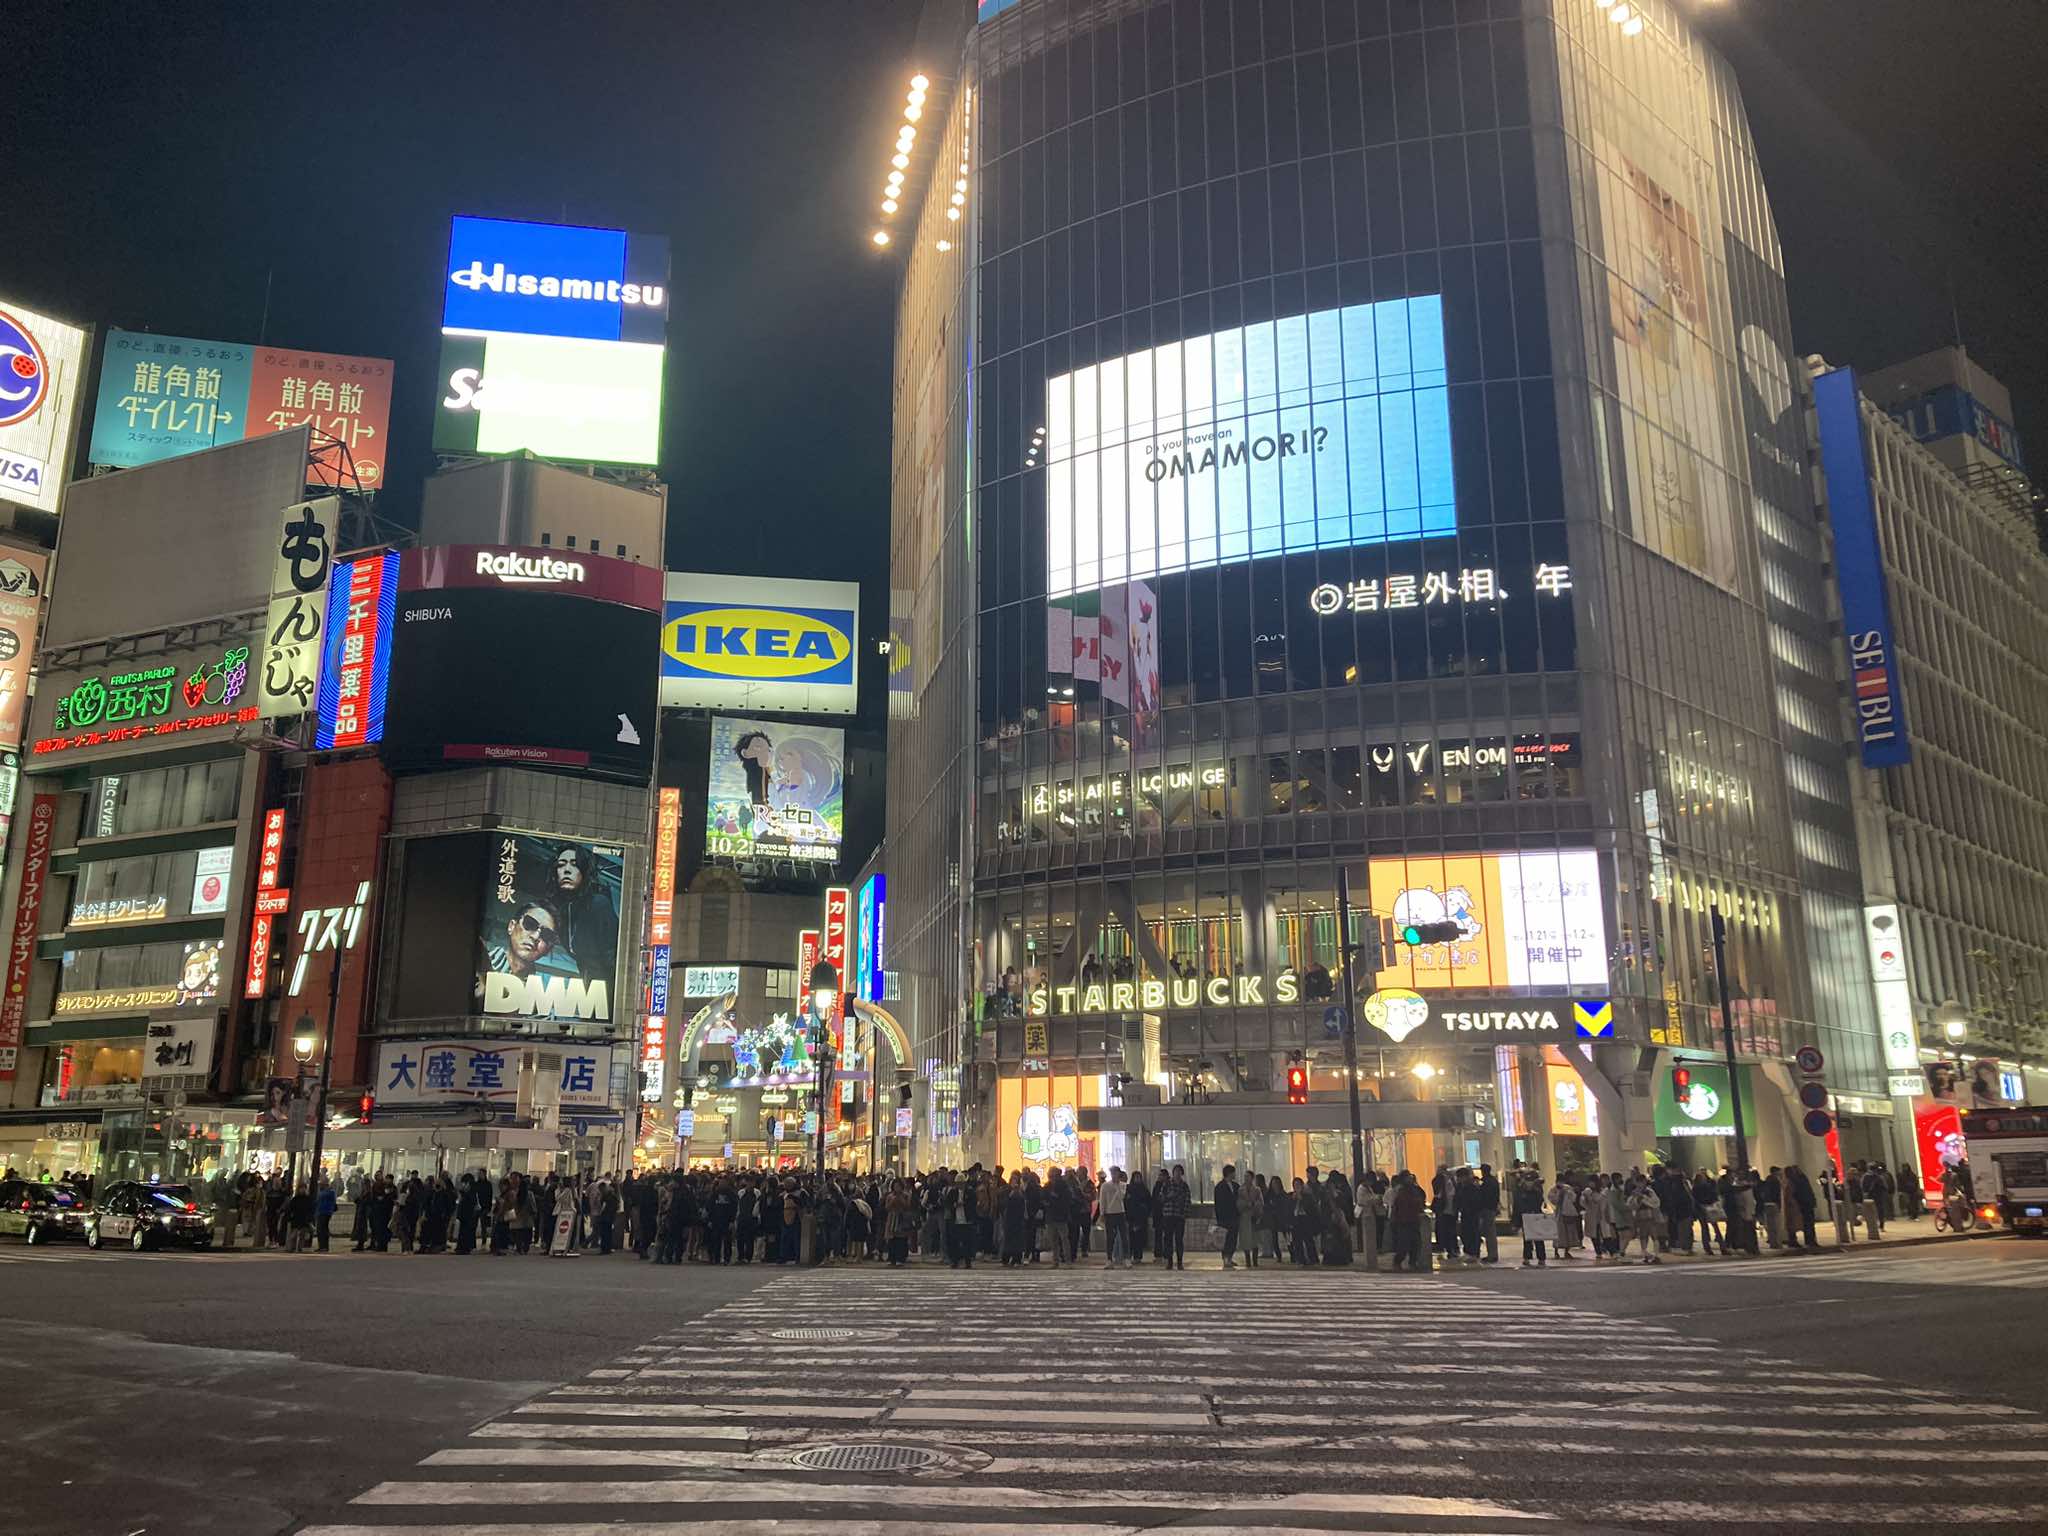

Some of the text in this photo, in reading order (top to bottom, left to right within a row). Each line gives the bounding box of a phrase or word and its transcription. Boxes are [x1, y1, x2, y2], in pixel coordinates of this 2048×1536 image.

[451, 261, 663, 306] Hisamitsu
[133, 361, 222, 400] 龍角散
[281, 377, 364, 415] 龍角散
[117, 396, 232, 435] ダイレクト
[1145, 426, 1328, 482] OMAMORI?
[476, 552, 585, 582] Rakuten
[1536, 563, 1572, 597] 年
[266, 507, 329, 707] もんじゃ
[404, 608, 452, 622] SHIBUYA
[334, 565, 373, 734] 三千里薬品
[677, 624, 836, 660] IKEA
[106, 681, 173, 722] 西村
[1849, 630, 1895, 743] SEIBU
[485, 747, 548, 759] Rakuten Vision
[101, 799, 114, 838] CAME
[496, 838, 518, 904] 外道の歌
[13, 820, 49, 981] ウィンターフルーツギフト
[1527, 946, 1583, 964] 開催中
[484, 972, 609, 1020] DMM
[1032, 974, 1298, 1015] STARBUCKS
[1442, 1011, 1559, 1031] TSUTAYA
[1670, 1125, 1735, 1136] STARBUCKS
